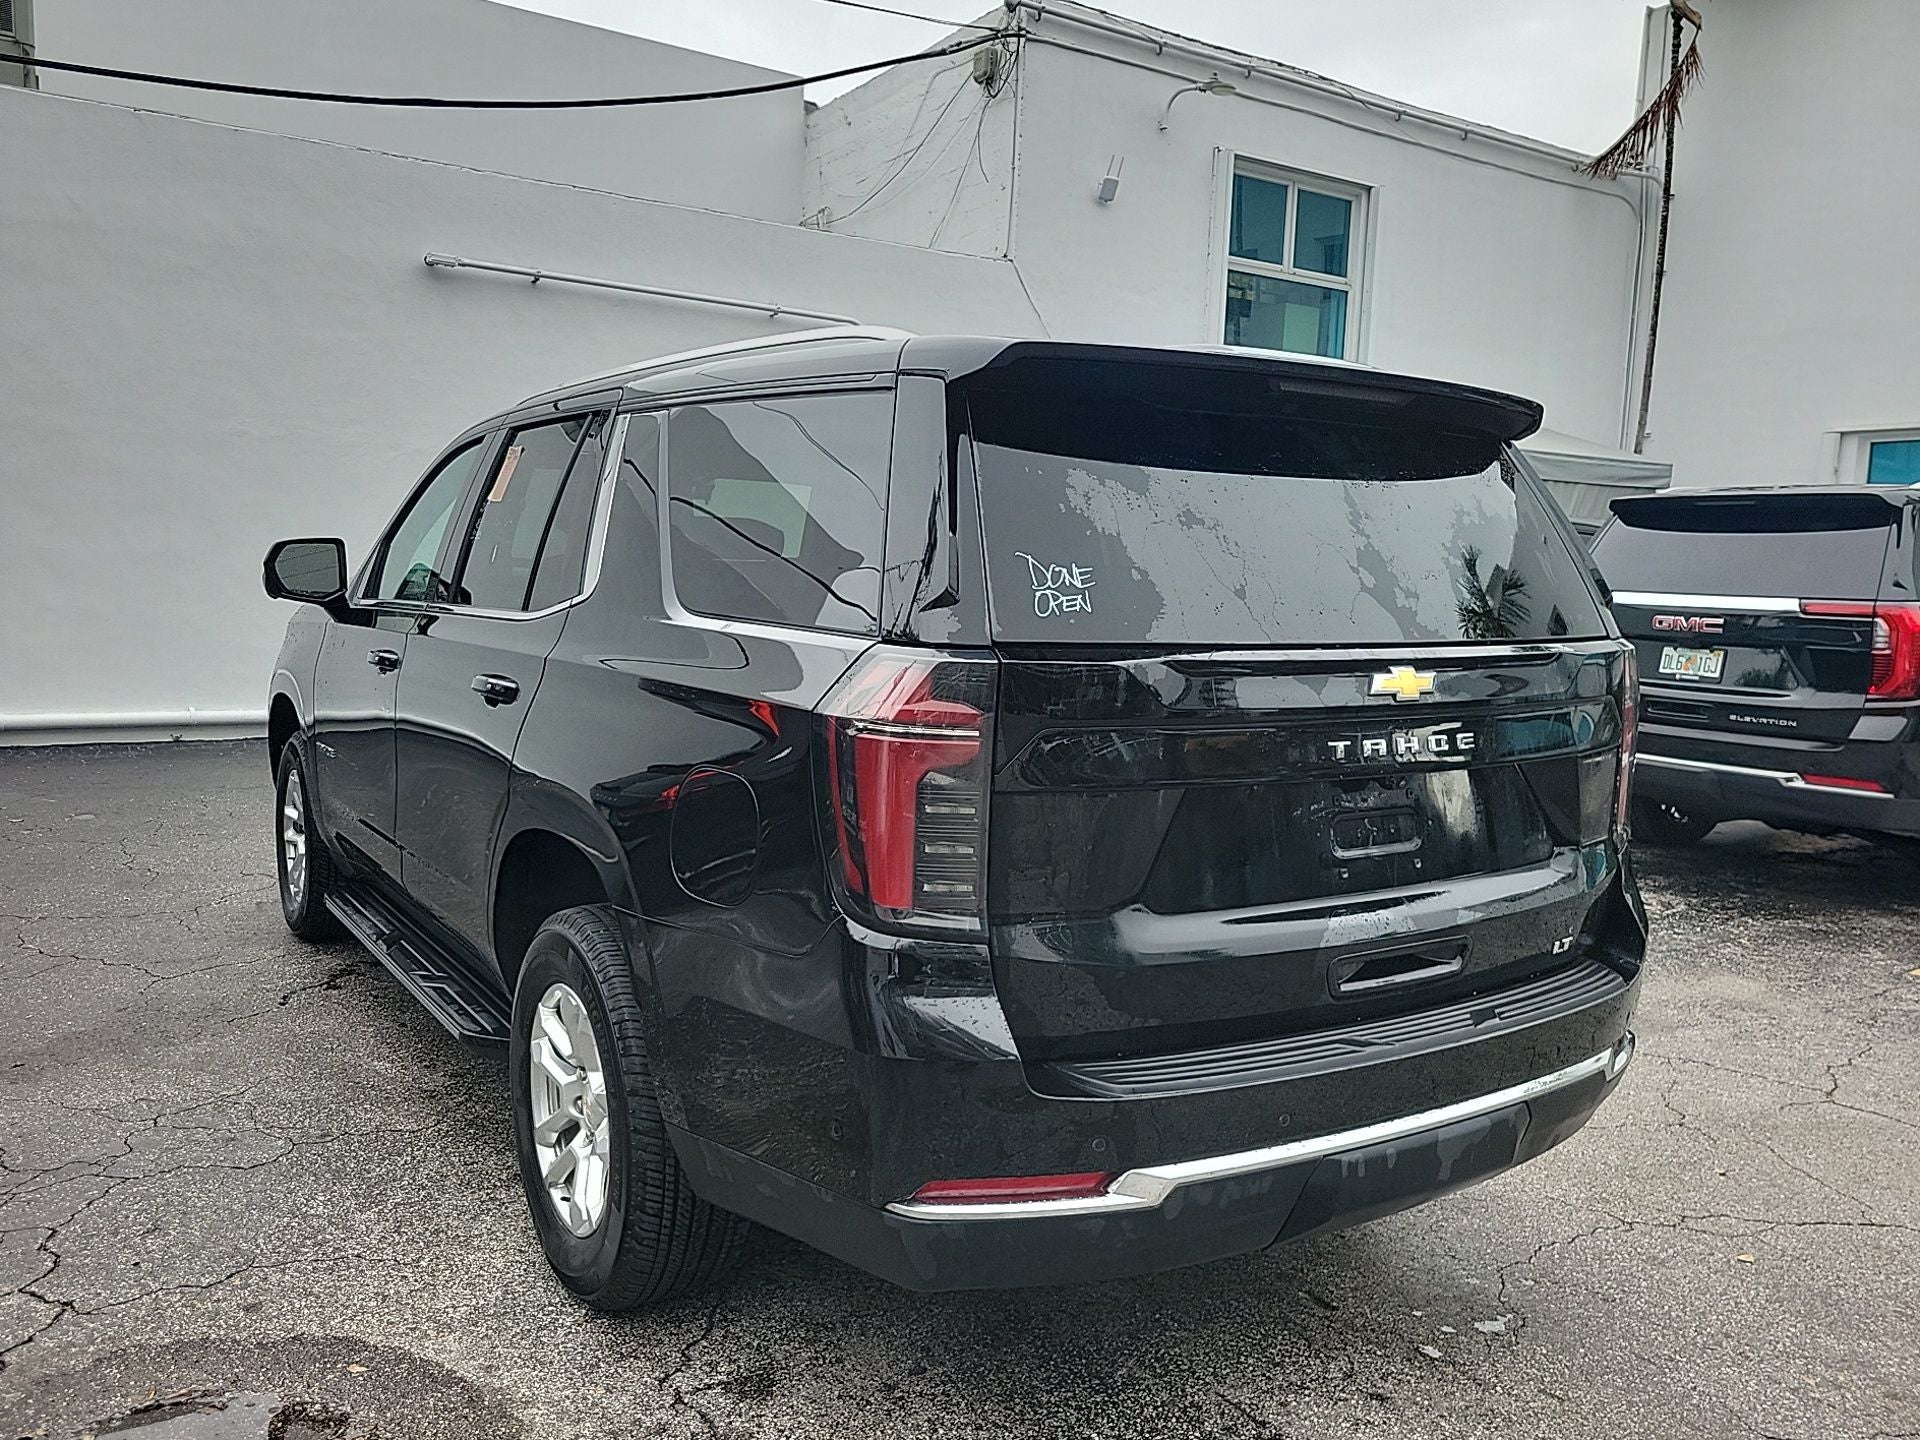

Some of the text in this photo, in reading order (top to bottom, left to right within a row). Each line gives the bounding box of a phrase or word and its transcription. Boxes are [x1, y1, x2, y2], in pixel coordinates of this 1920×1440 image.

[1014, 551, 1096, 590] DONE
[1034, 589, 1092, 617] OPEN
[1652, 614, 1725, 634] GMC
[1728, 713, 1798, 728] ELEVATION
[1327, 732, 1476, 760] TAHOE
[1552, 935, 1574, 955] LT
